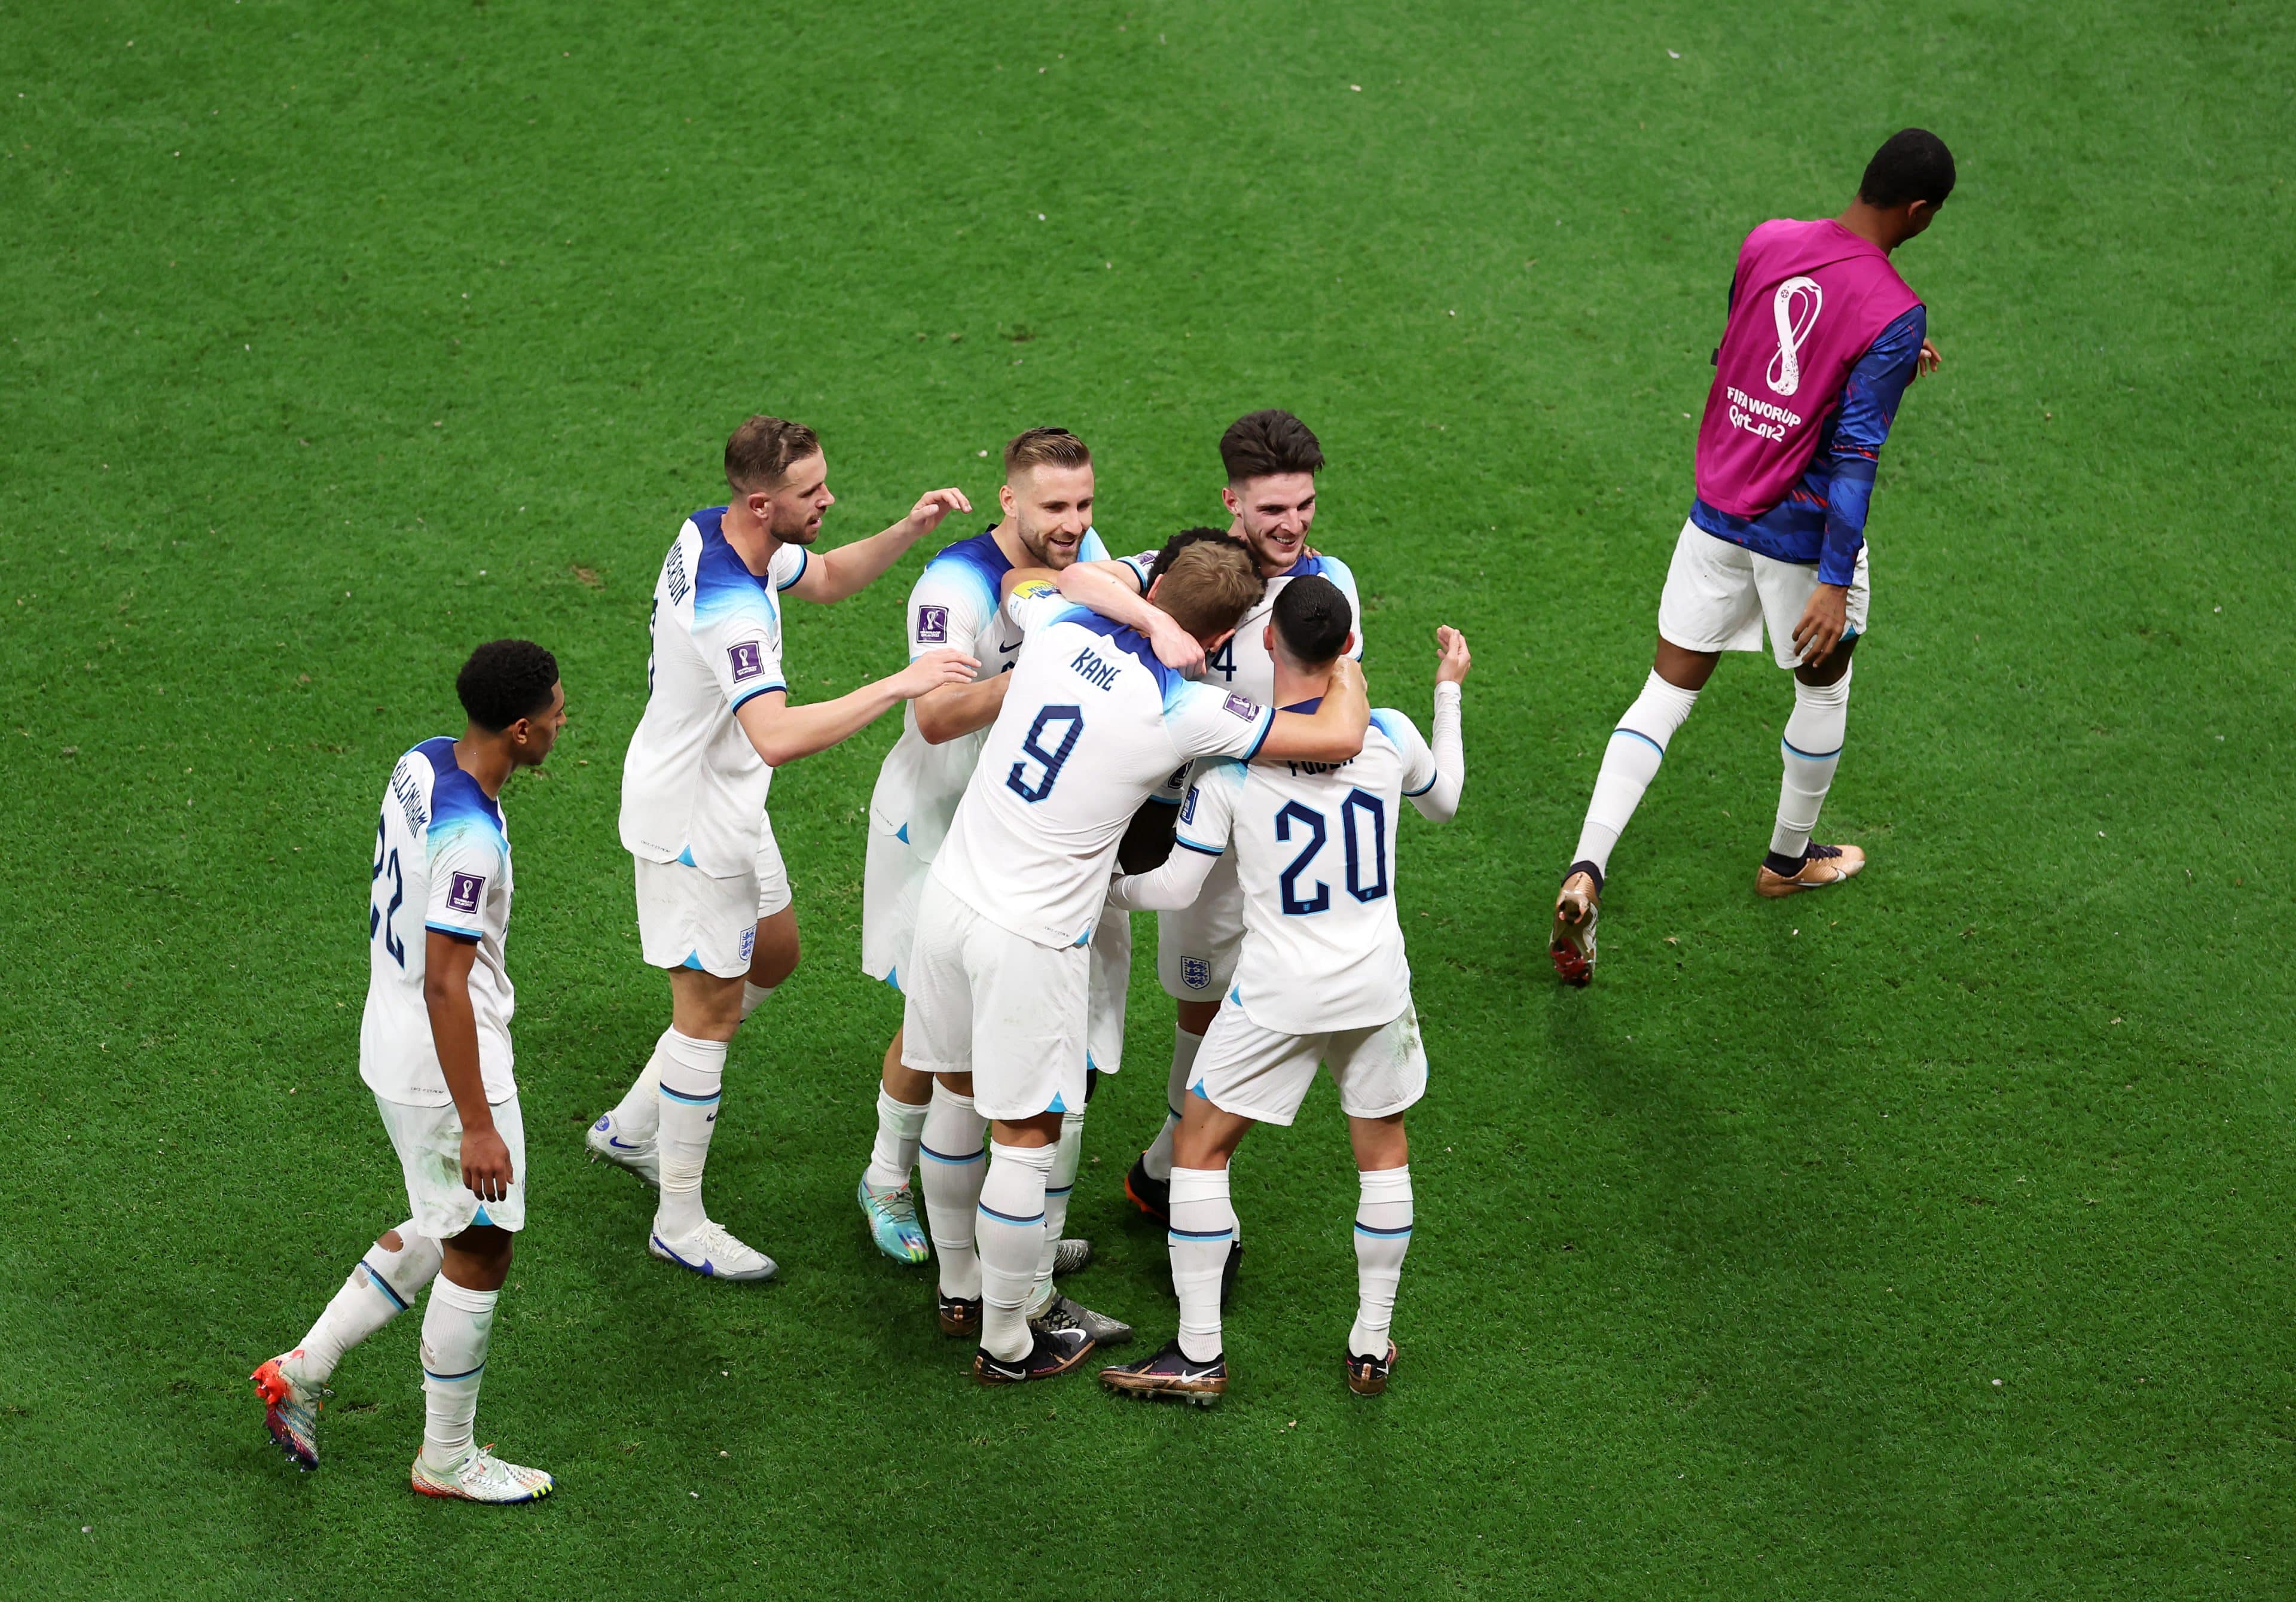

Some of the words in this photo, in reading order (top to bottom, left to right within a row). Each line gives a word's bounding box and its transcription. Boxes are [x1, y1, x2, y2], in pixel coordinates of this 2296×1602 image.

[1727, 386, 1748, 410] FIFA
[1070, 646, 1122, 692] KANE
[1211, 636, 1237, 682] 4
[1004, 704, 1086, 804] 9
[1274, 786, 1388, 916] 20
